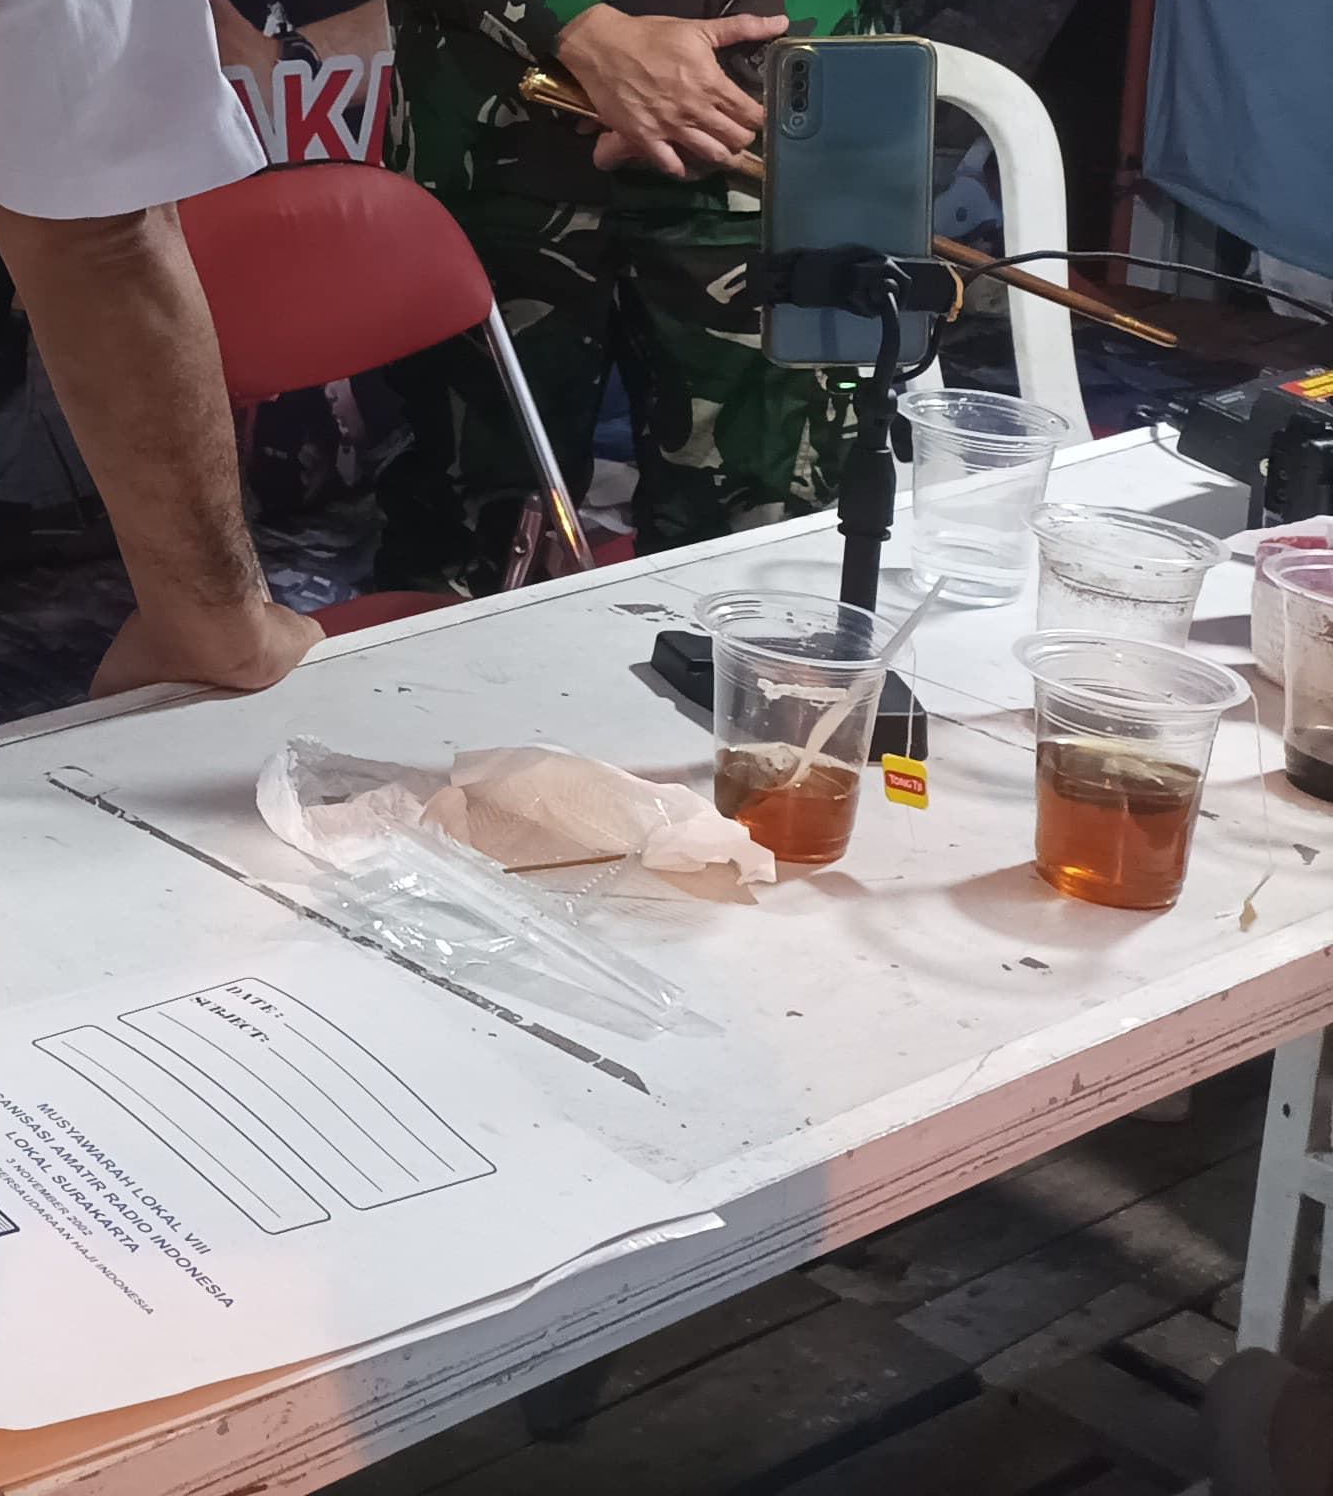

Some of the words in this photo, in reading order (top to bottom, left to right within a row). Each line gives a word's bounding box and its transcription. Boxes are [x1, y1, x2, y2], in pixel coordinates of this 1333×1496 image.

[5, 1130, 52, 1173] LOKAL
[51, 1175, 141, 1253] SURAKARTA
[13, 1164, 70, 1216] NOVEMBER
[36, 1102, 137, 1188] MUSYAWARAH
[133, 1187, 184, 1233] LOKAL
[185, 1232, 212, 1255] VIII
[50, 1145, 106, 1192] AMATIR
[103, 1193, 153, 1234] RADIO
[150, 1235, 235, 1308] INDONESIA
[73, 1238, 99, 1263] HAJI
[96, 1262, 155, 1315] INDONESIA
